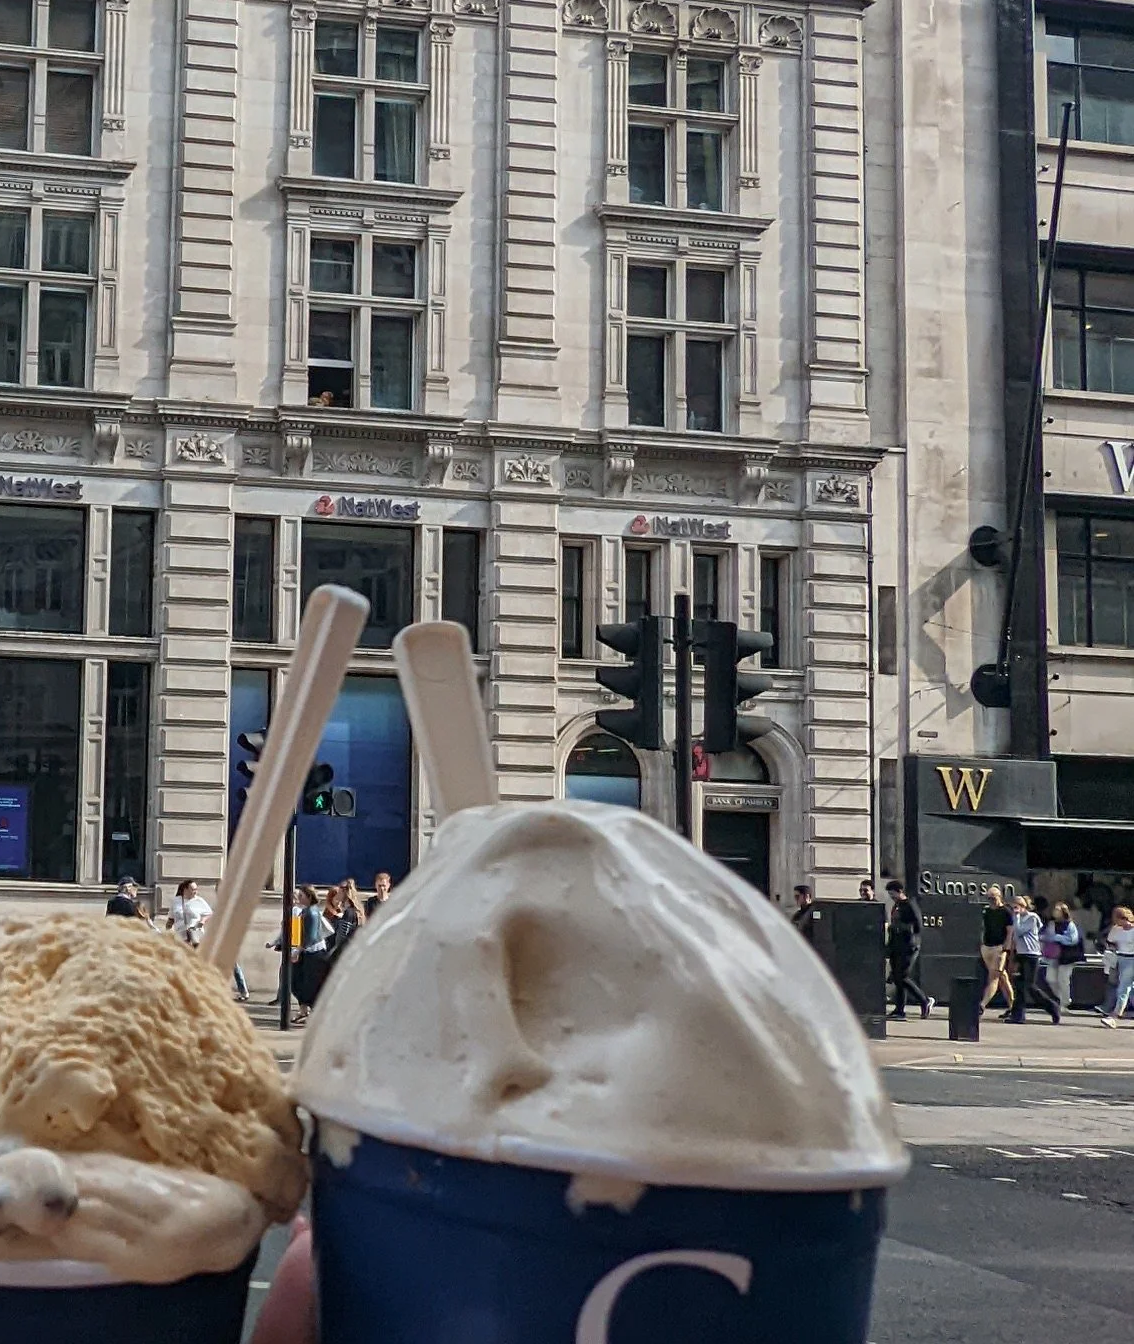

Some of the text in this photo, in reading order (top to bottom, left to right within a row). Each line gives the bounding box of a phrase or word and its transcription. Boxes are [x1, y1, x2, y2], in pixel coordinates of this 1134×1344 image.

[339, 496, 421, 521] NatWest
[653, 516, 732, 540] NatWest
[936, 766, 993, 811] W
[923, 916, 943, 927] 206
